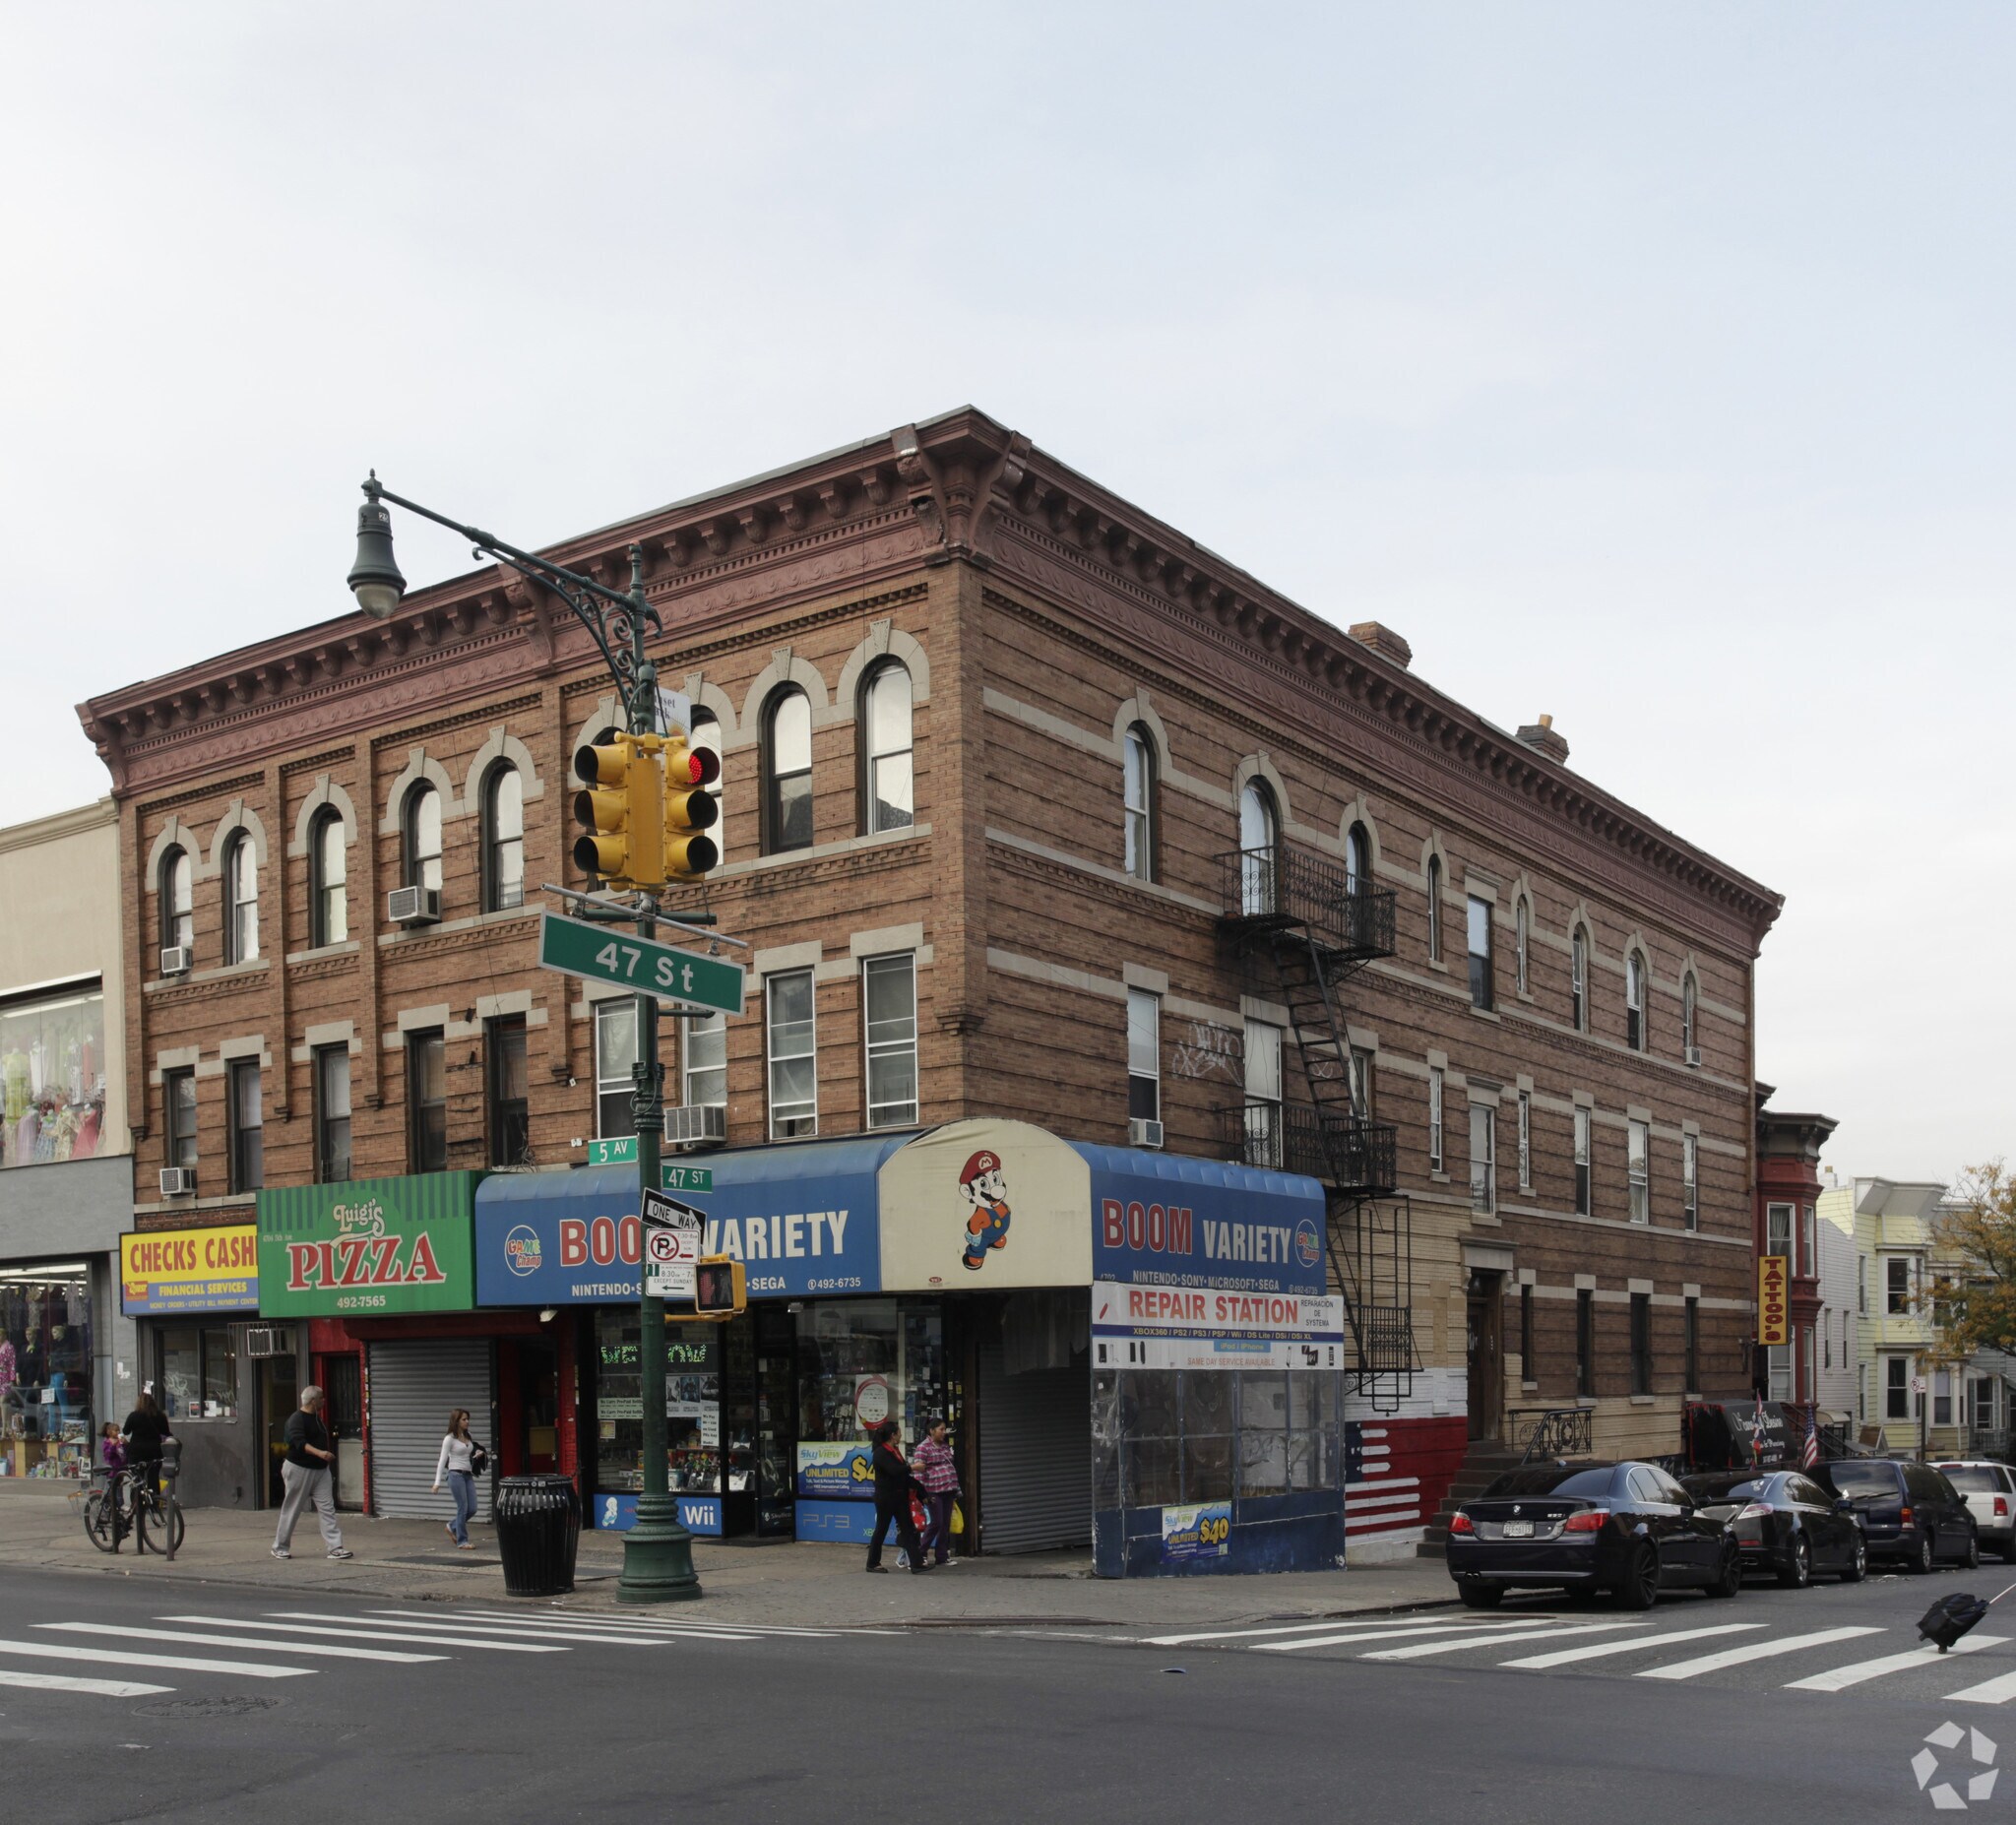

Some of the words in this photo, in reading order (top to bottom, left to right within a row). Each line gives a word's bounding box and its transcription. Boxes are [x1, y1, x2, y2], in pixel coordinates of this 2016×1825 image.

[596, 942, 641, 977] 47
[655, 957, 694, 993] St
[599, 1143, 608, 1163] 5
[613, 1141, 628, 1155] AV
[668, 1168, 686, 1188] 47
[691, 1170, 705, 1184] ST
[333, 1198, 385, 1237] Luigi's
[652, 1203, 671, 1222] ONE
[678, 1214, 697, 1229] WAY
[559, 1215, 641, 1267] BOO
[1102, 1198, 1193, 1255] BOOM
[1202, 1220, 1292, 1264] VARIETY
[130, 1239, 197, 1274] CHECKS
[507, 1237, 541, 1255] GAME
[285, 1230, 447, 1291] PIZZA
[516, 1255, 542, 1270] Champ
[158, 1283, 205, 1297] FINANCIAL
[207, 1282, 247, 1294] SERVICES
[1764, 1259, 1784, 1341] TATTOO'S
[337, 1295, 386, 1309] 492-7565
[1129, 1290, 1206, 1320] REPAIR
[1216, 1295, 1298, 1324] STATION
[1133, 1327, 1167, 1336] XBOX360
[1192, 1329, 1207, 1338] PS3
[1187, 1356, 1206, 1365] SAME
[1219, 1357, 1244, 1366] SERVICE
[805, 1468, 850, 1478] UNLIMITED
[684, 1505, 714, 1526] Wii
[802, 1513, 850, 1529] PS3
[1200, 1517, 1229, 1544] $40
